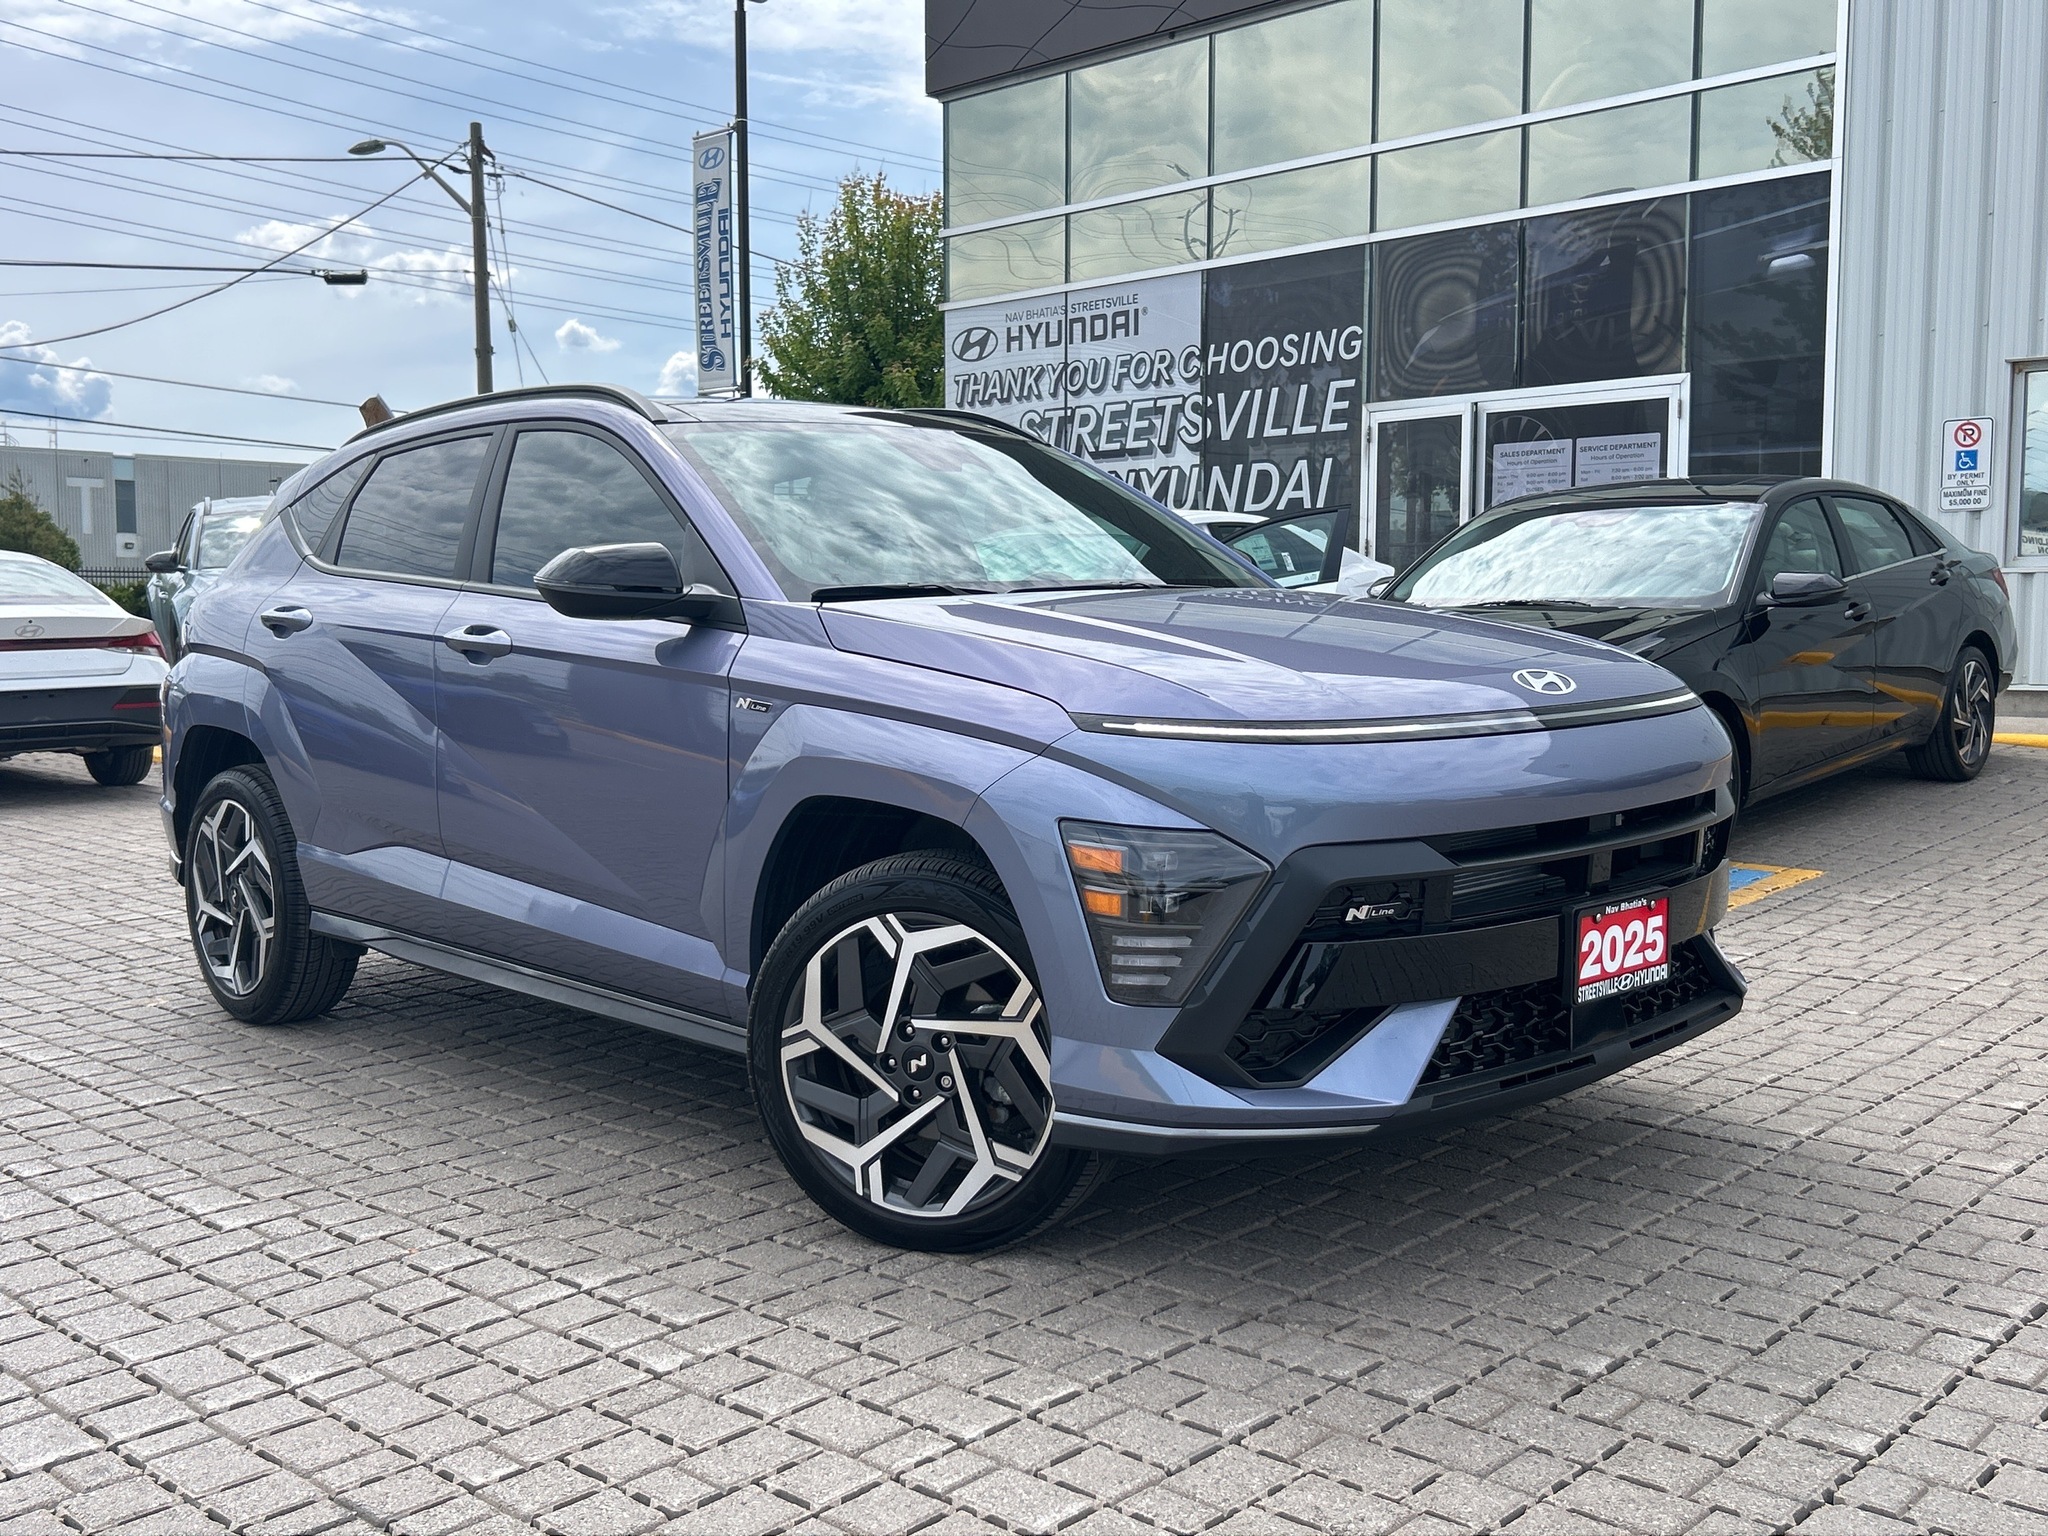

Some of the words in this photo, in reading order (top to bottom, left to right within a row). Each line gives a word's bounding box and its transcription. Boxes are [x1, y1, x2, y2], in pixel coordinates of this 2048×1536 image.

[696, 178, 726, 372] STREETSVILLE
[718, 208, 731, 338] HYUNDAI
[1005, 313, 1024, 323] NAV
[1026, 304, 1066, 320] BHATIA'S
[1071, 294, 1139, 314] STREETSVILLE
[954, 365, 1044, 407] THANK
[1048, 354, 1109, 399] YOU
[1112, 349, 1175, 393] FOR
[1178, 325, 1363, 380] CHOOSING
[1020, 378, 1357, 456] STREETSVILLE
[1521, 448, 1565, 457] DEPARTMENT
[1580, 445, 1608, 453] SERVICE
[1609, 442, 1657, 450] DEPARTMENT
[736, 697, 751, 710] N
[1345, 905, 1369, 921] N
[1371, 908, 1394, 916] Line
[1605, 904, 1618, 914] Nav
[1620, 898, 1647, 911] Bhatia's
[1580, 915, 1665, 980] 2025
[1578, 977, 1618, 1003] STREETSVILLE
[1634, 963, 1668, 987] HYUNDAI
